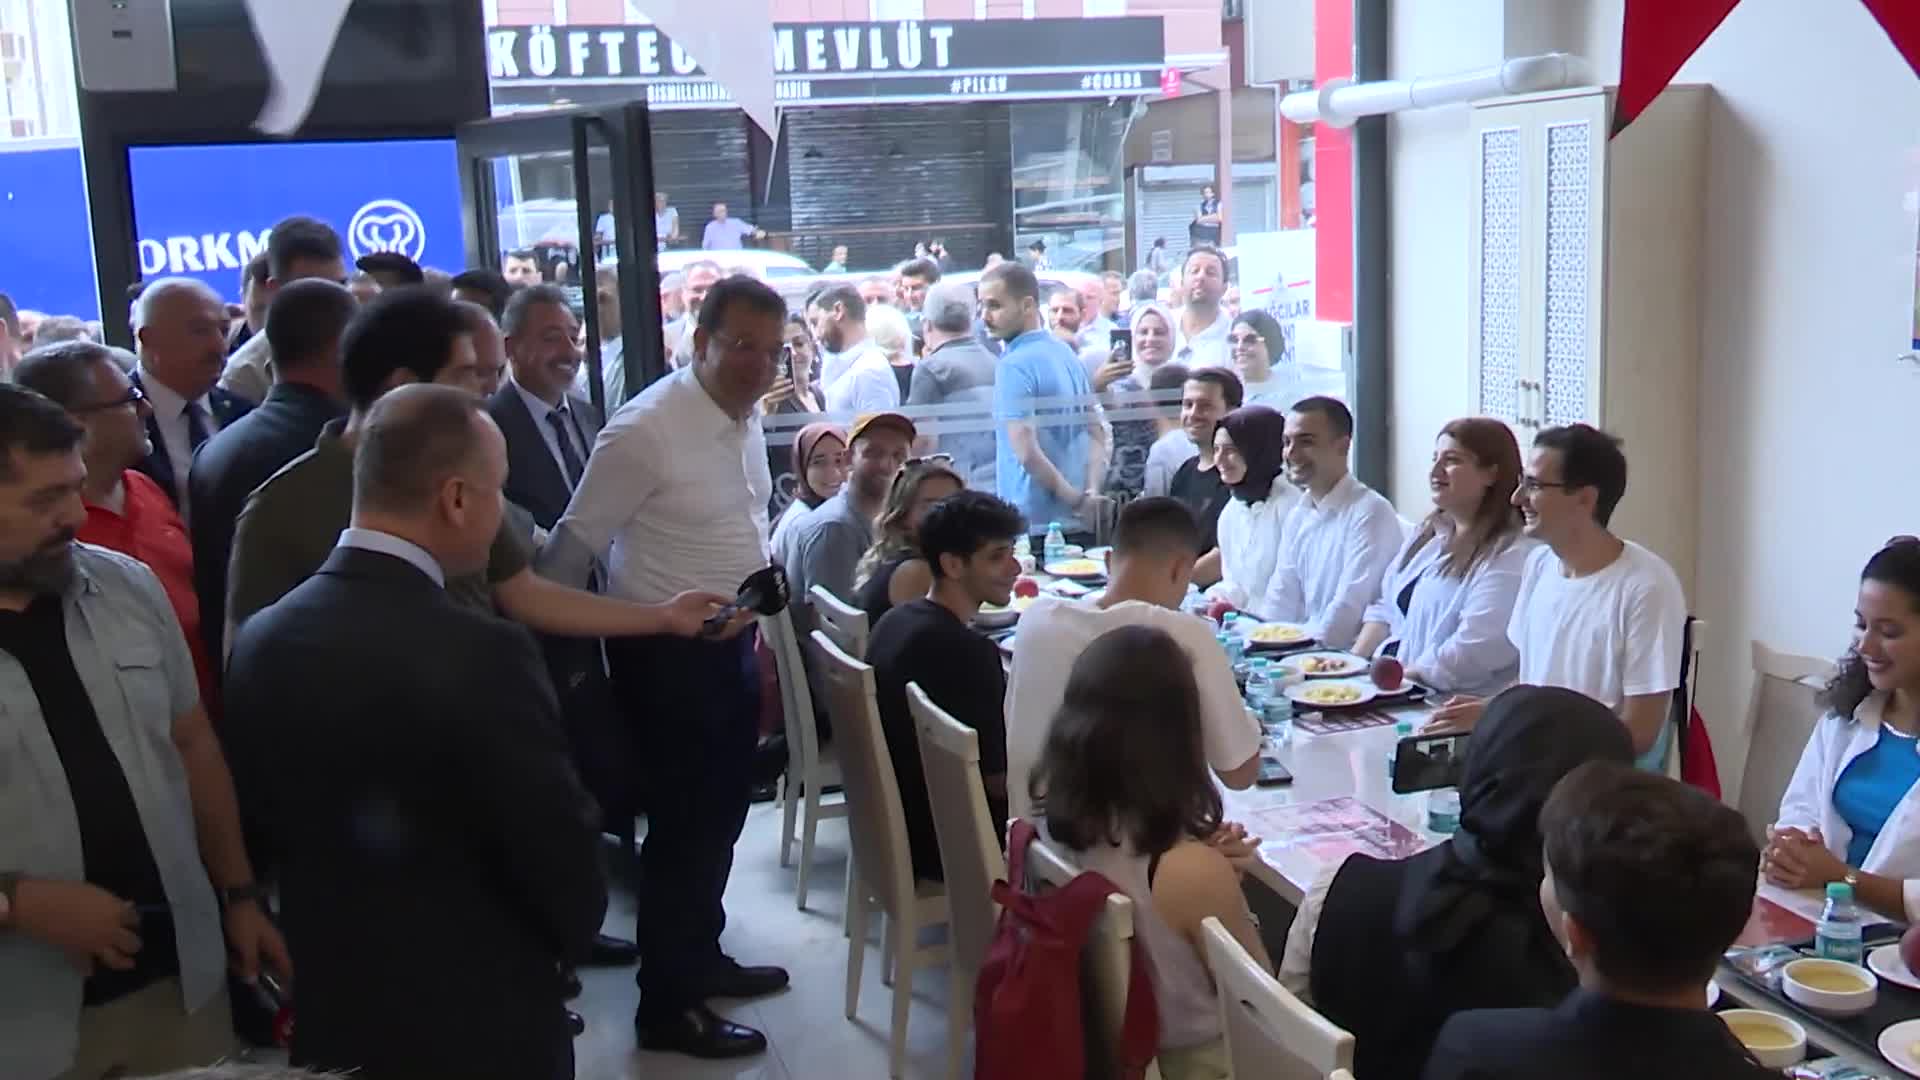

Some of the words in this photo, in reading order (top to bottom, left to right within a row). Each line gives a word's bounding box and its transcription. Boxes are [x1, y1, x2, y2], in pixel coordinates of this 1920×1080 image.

[489, 25, 697, 76] KÖFTEC
[774, 21, 953, 72] MEVLÜT
[138, 229, 273, 275] ORKM
